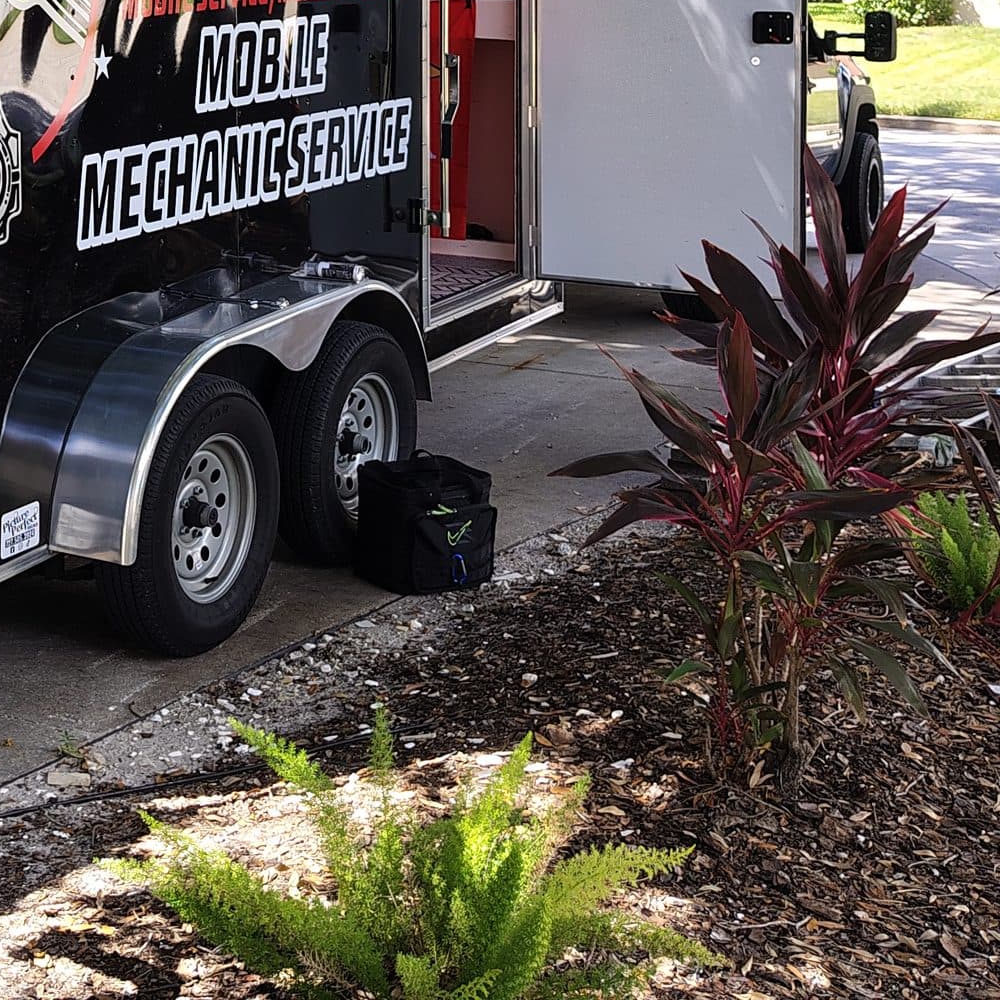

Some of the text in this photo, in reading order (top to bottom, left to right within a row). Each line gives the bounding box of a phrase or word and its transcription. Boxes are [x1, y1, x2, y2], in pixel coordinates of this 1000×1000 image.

[195, 14, 330, 113] MOBILE
[77, 97, 412, 251] MECHANIC SERVICE
[2, 510, 29, 533] Picture
